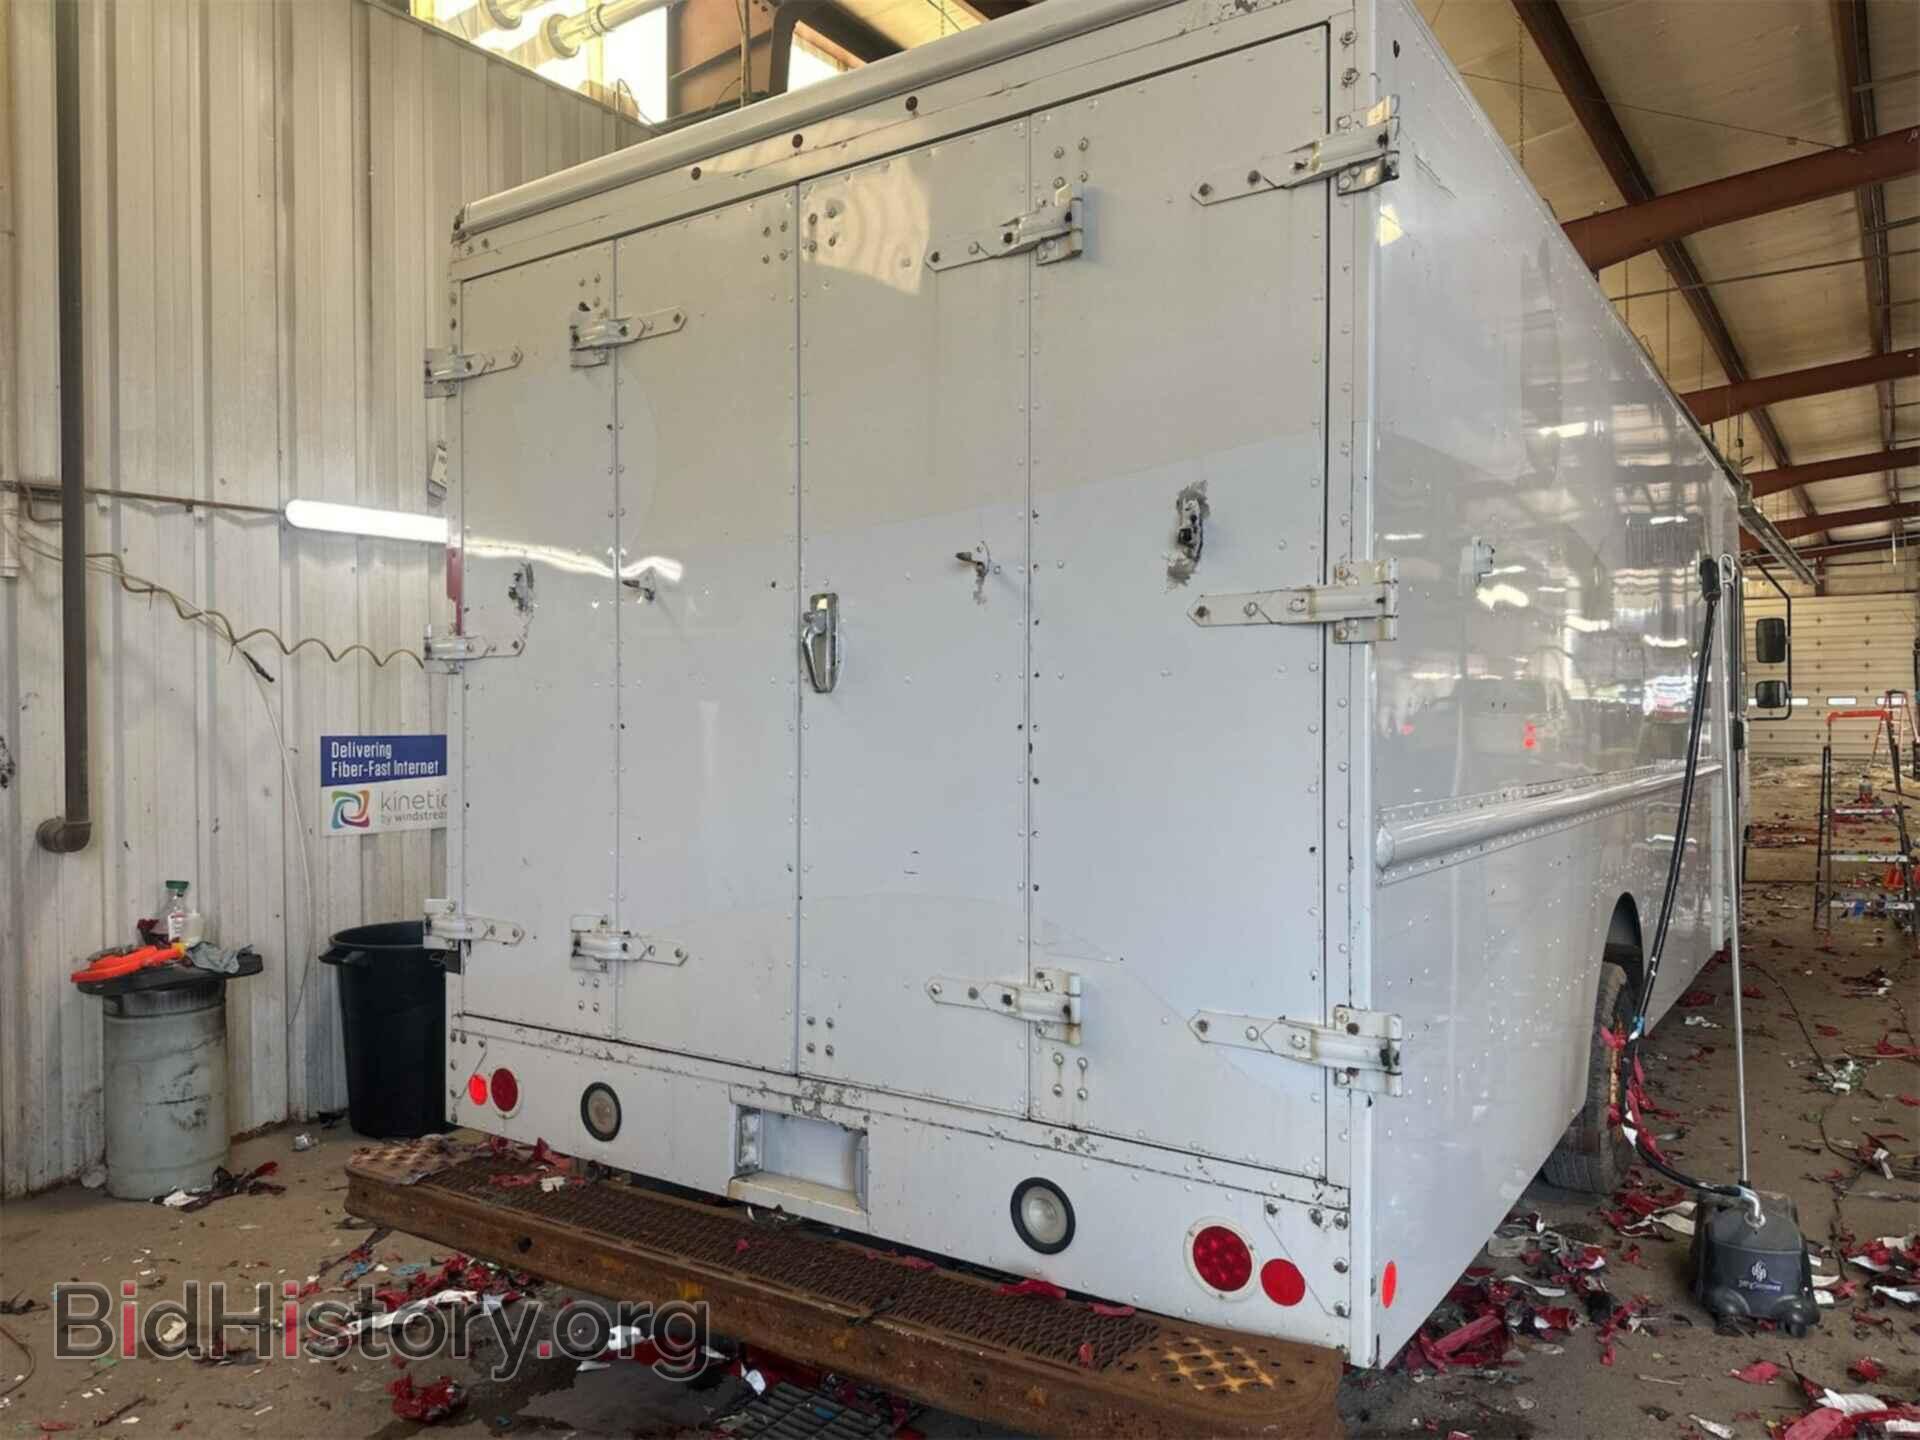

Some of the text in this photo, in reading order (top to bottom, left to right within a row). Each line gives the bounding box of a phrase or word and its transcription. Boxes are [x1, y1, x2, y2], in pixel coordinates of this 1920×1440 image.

[331, 741, 392, 759] Delivering
[331, 760, 439, 778] Fiber-Fast Internet
[381, 788, 447, 810] kinetic
[394, 811, 447, 823] windstrea
